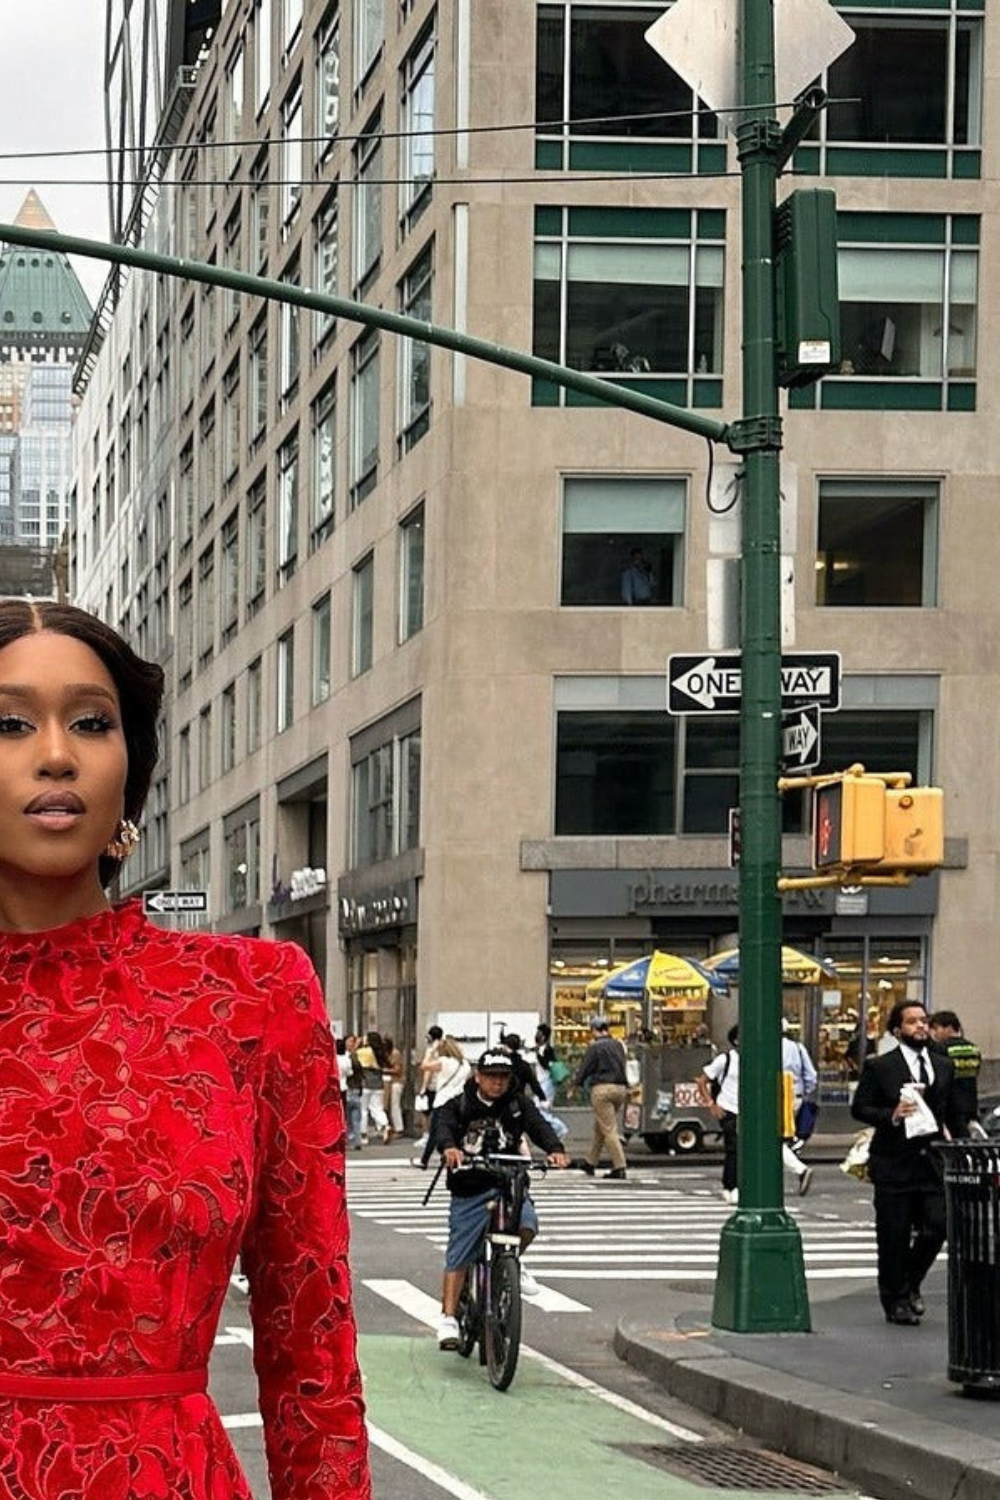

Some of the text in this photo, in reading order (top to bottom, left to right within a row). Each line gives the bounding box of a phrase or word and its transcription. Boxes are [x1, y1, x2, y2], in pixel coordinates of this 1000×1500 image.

[687, 672, 741, 695] ONE
[788, 727, 810, 751] WAY
[182, 898, 201, 907] WAY
